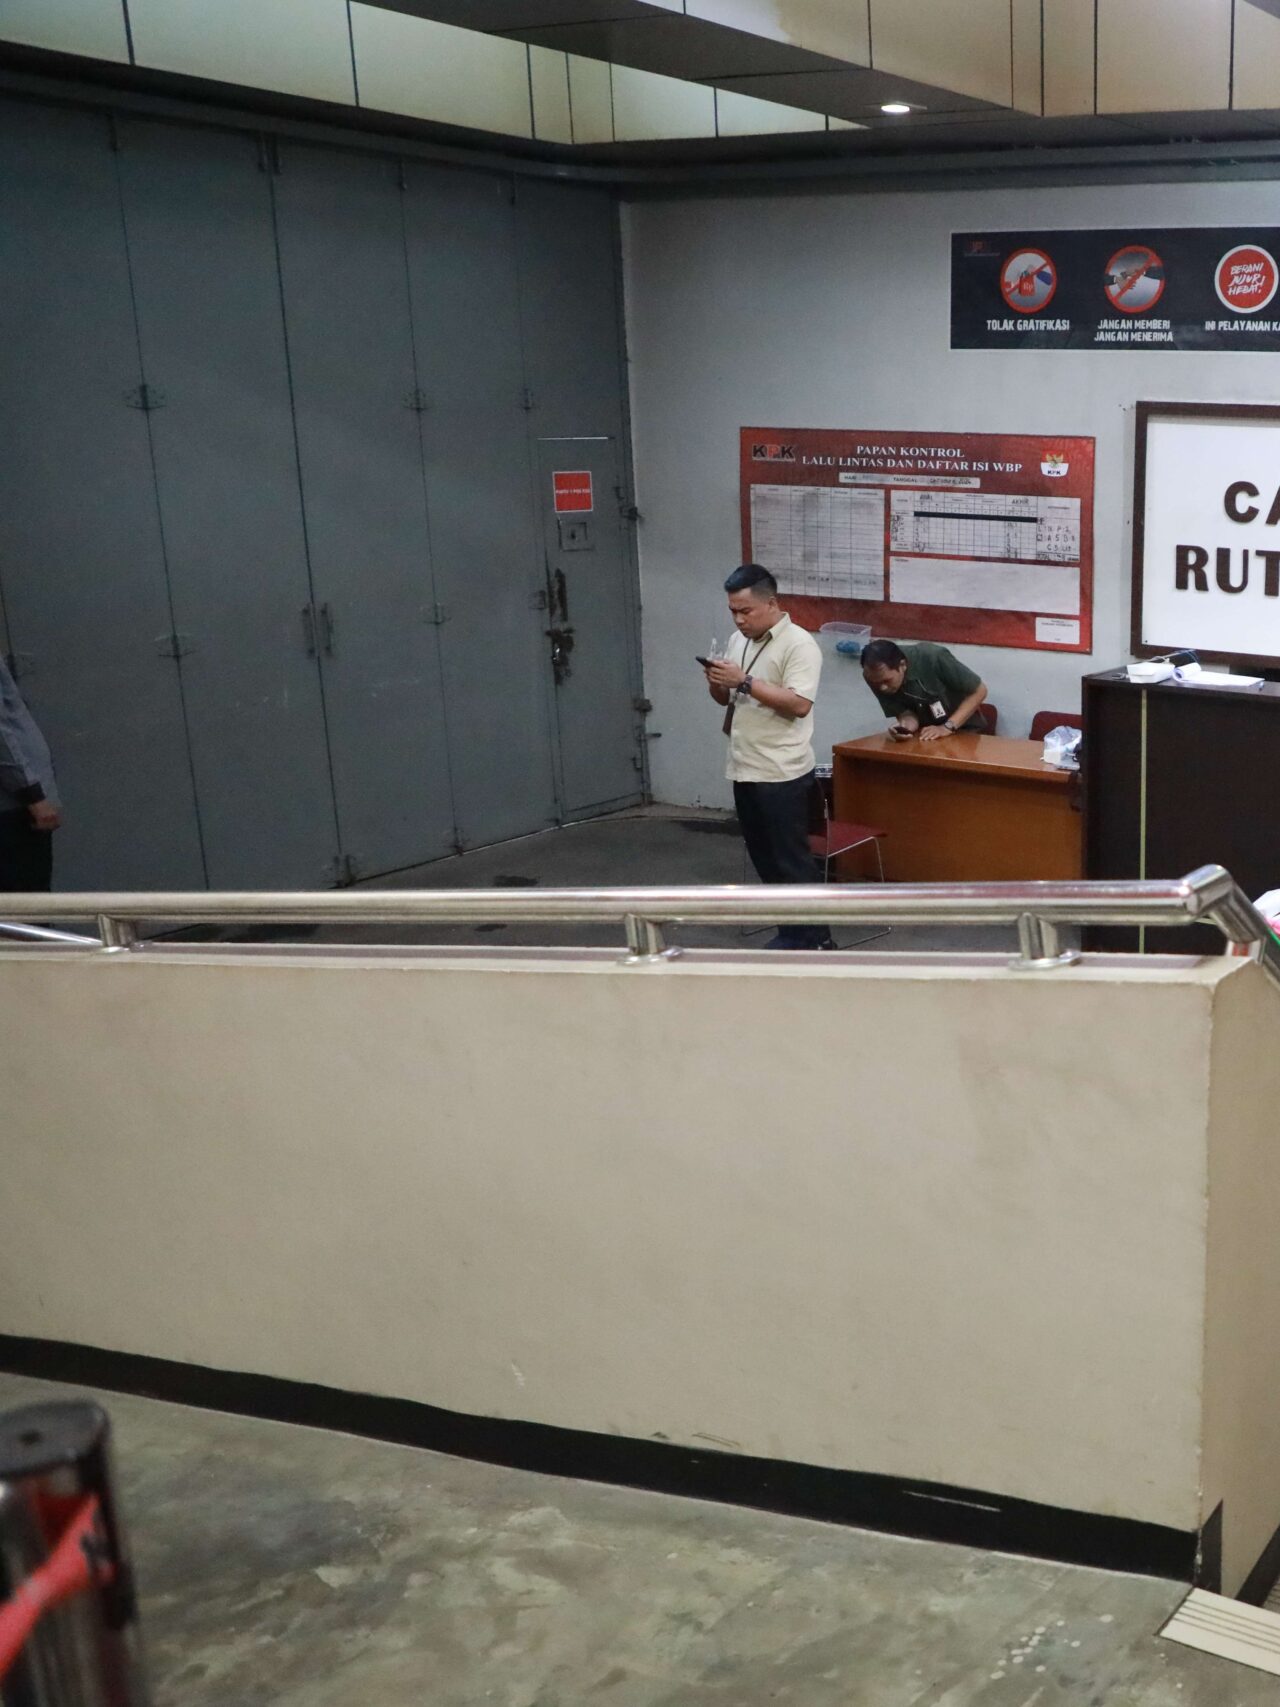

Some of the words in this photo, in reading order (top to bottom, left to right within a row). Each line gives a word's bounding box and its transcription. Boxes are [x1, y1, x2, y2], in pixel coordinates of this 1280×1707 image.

[1230, 262, 1264, 275] BERANI
[986, 319, 1015, 331] TOLAK
[1017, 319, 1070, 331] GRATIFIKASI
[1097, 319, 1133, 330] JANGAN
[1134, 319, 1171, 330] MEMBERI
[1205, 320, 1216, 331] INI
[1218, 320, 1271, 332] PELAYANAN
[1094, 331, 1129, 342] JANGAN
[1130, 331, 1174, 342] MENERIMA
[752, 444, 795, 459] KPK
[857, 445, 896, 456] PAPAN
[900, 447, 965, 458] KONTROL
[802, 456, 835, 466] LALU
[839, 457, 884, 467] LINTAS
[887, 459, 913, 469] DAN
[917, 461, 969, 471] DAFTAR
[972, 462, 989, 472] ISI
[993, 463, 1023, 473] WBP
